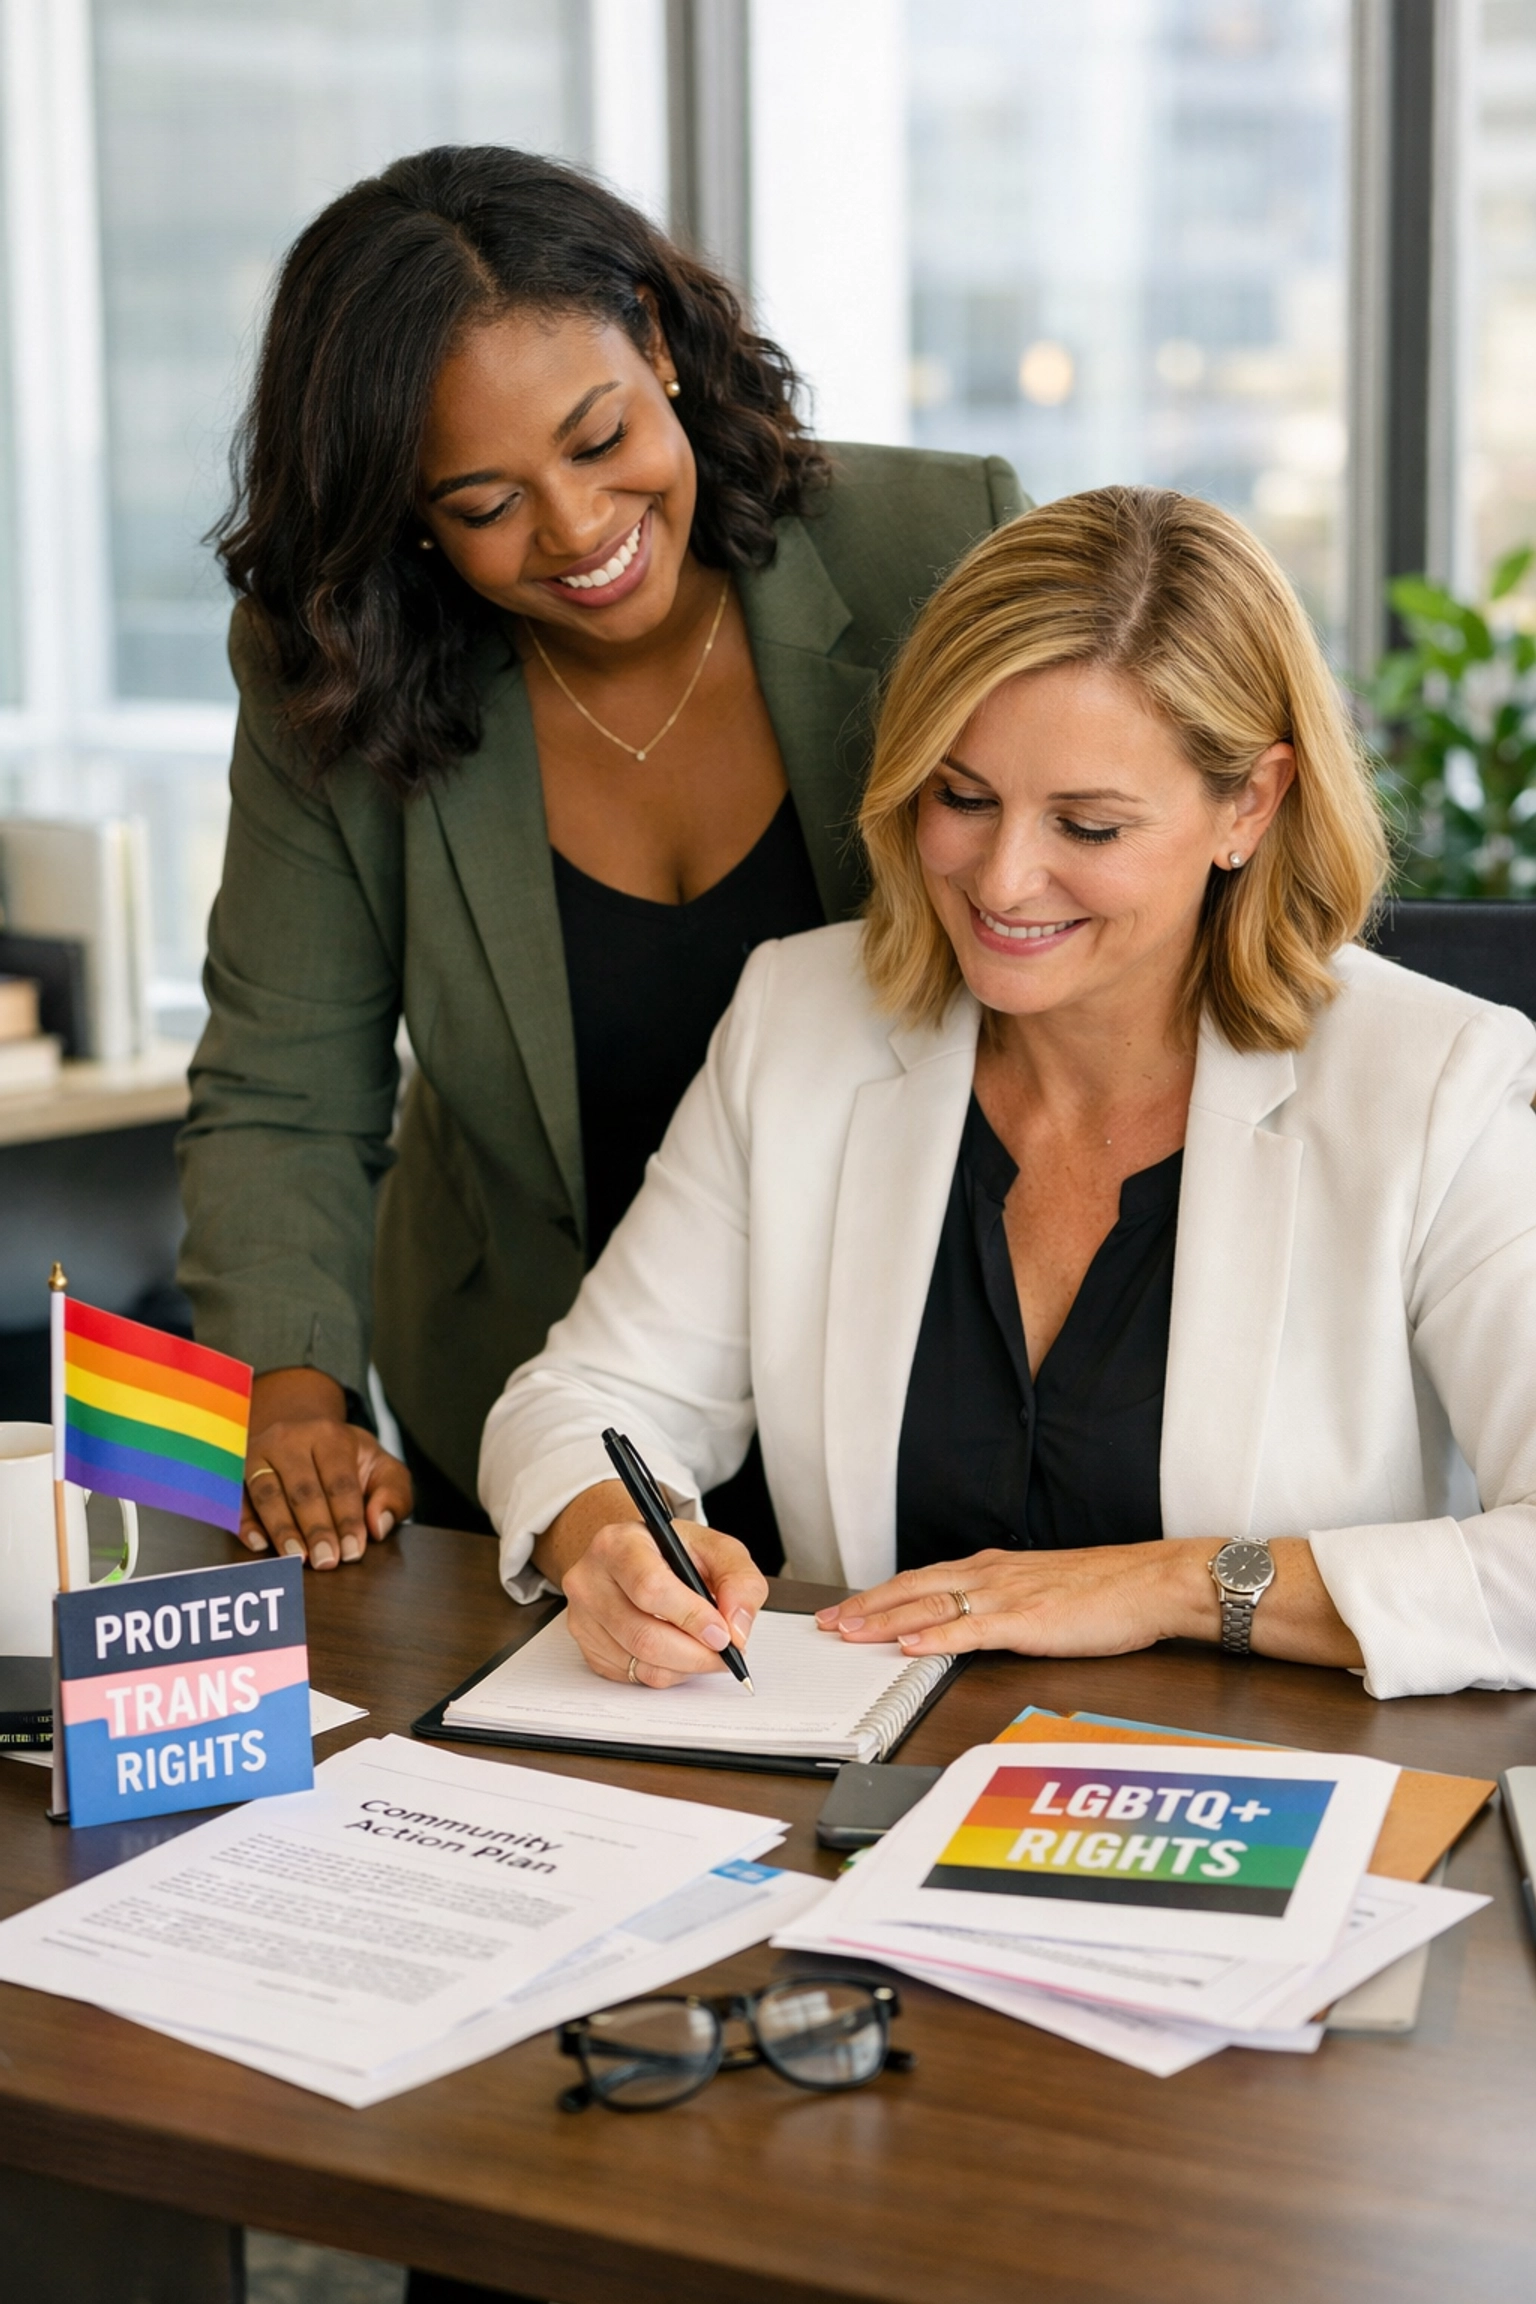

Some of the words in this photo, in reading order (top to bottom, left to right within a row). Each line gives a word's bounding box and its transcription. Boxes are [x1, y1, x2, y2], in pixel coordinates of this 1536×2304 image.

[95, 1588, 285, 1659] PROTECT
[106, 1666, 261, 1737] TRANS
[116, 1730, 267, 1796] RIGHTS
[360, 1800, 564, 1854] Community
[1029, 1781, 1272, 1831] LGBTQ+
[344, 1819, 467, 1853] Action
[471, 1845, 558, 1875] Plan
[1006, 1827, 1248, 1878] RIGHTS
